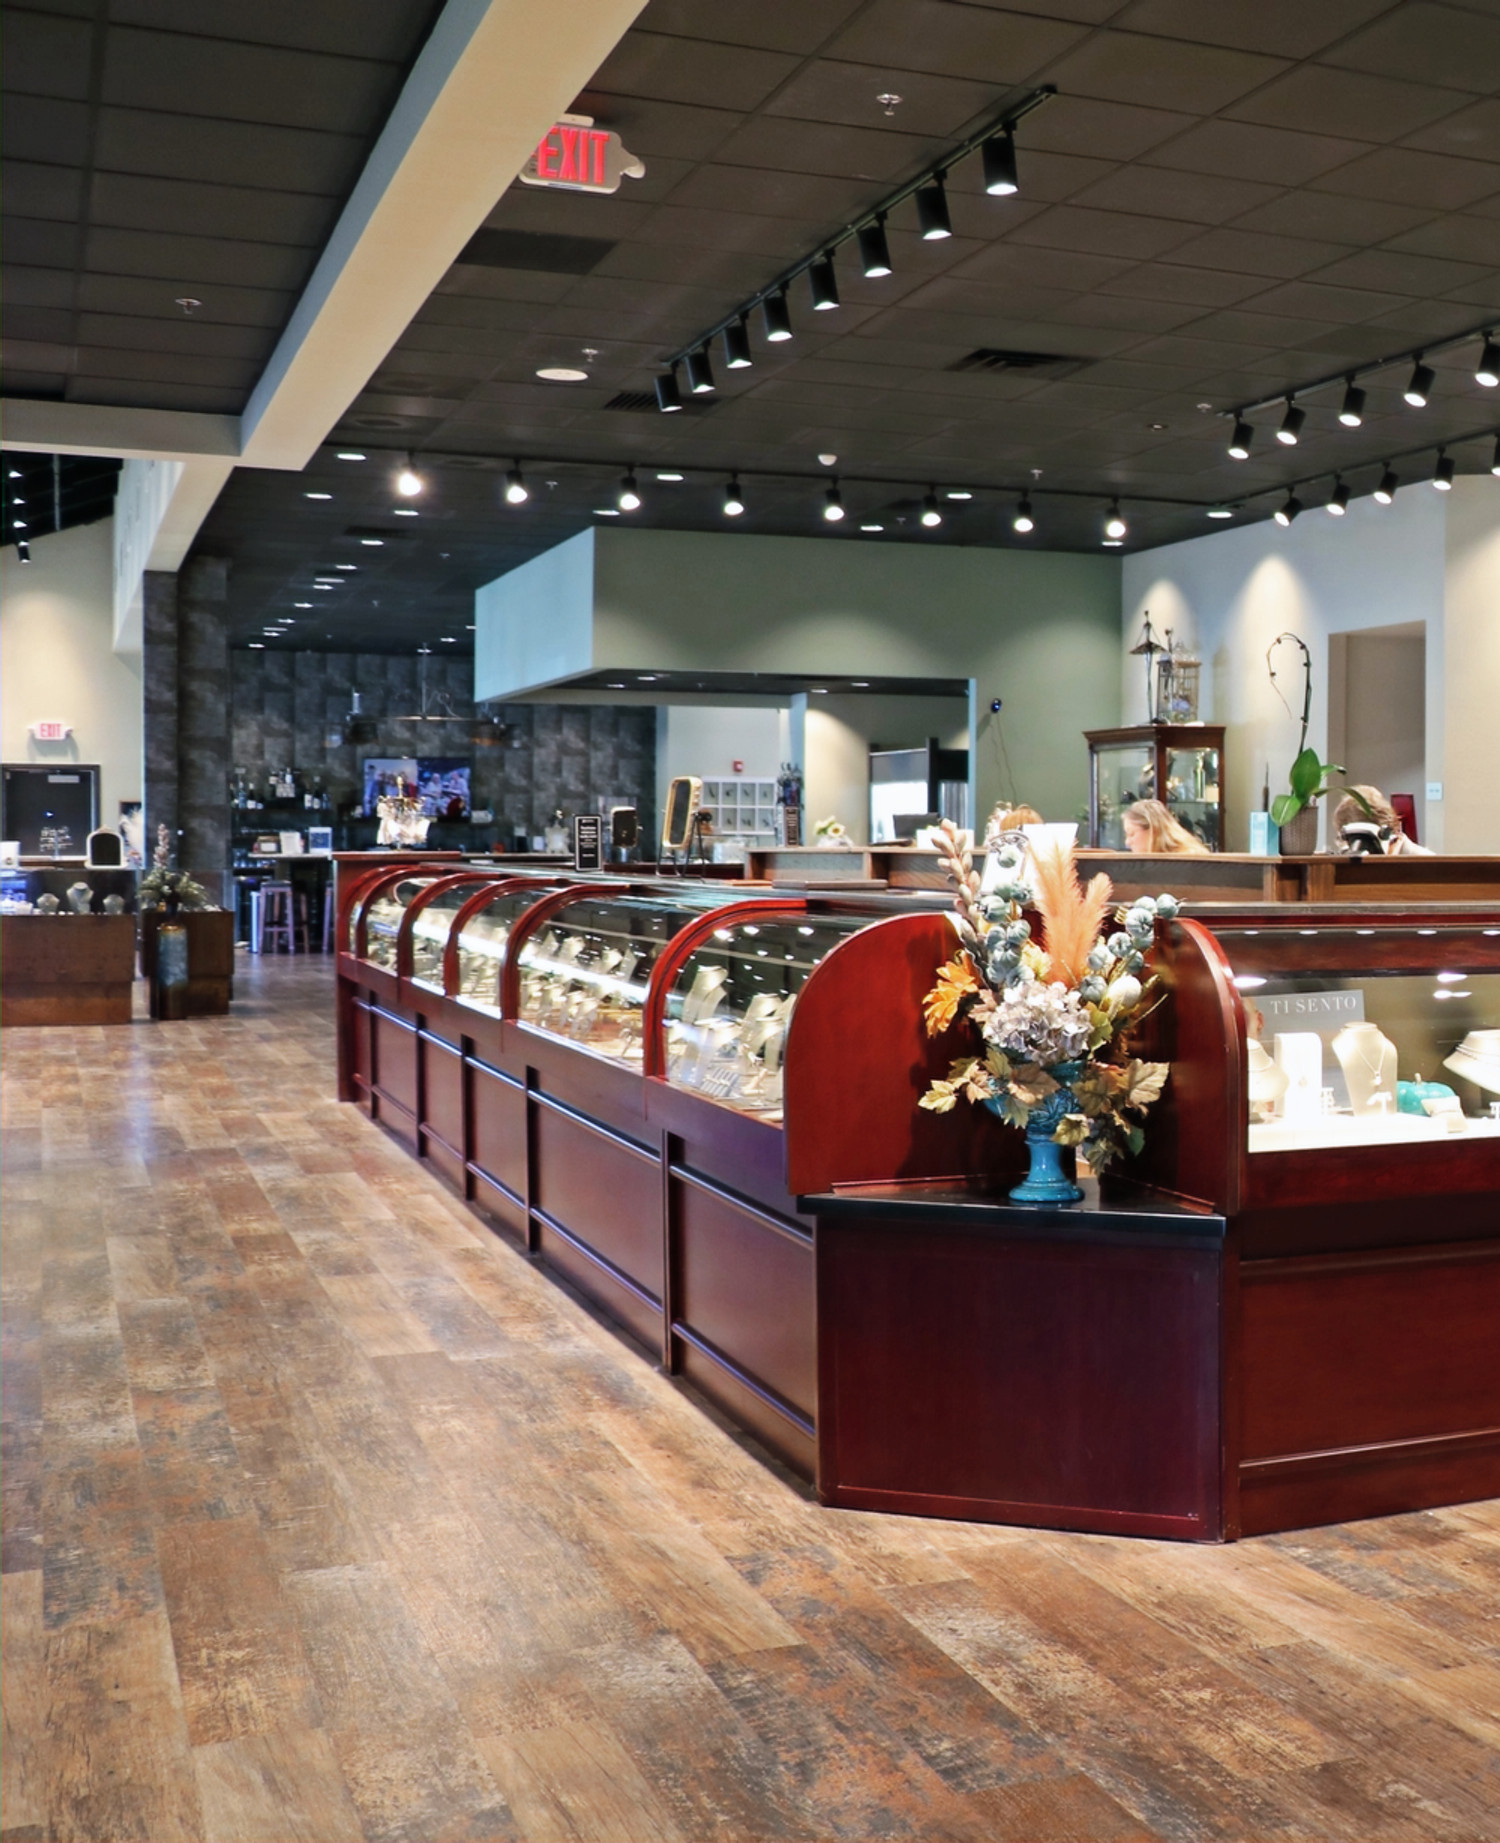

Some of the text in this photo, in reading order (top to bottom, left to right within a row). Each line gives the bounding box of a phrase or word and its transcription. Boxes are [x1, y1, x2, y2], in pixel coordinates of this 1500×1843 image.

[537, 124, 610, 186] EXIT
[40, 722, 61, 738] EXIT
[1270, 995, 1357, 1015] TI SENTO
